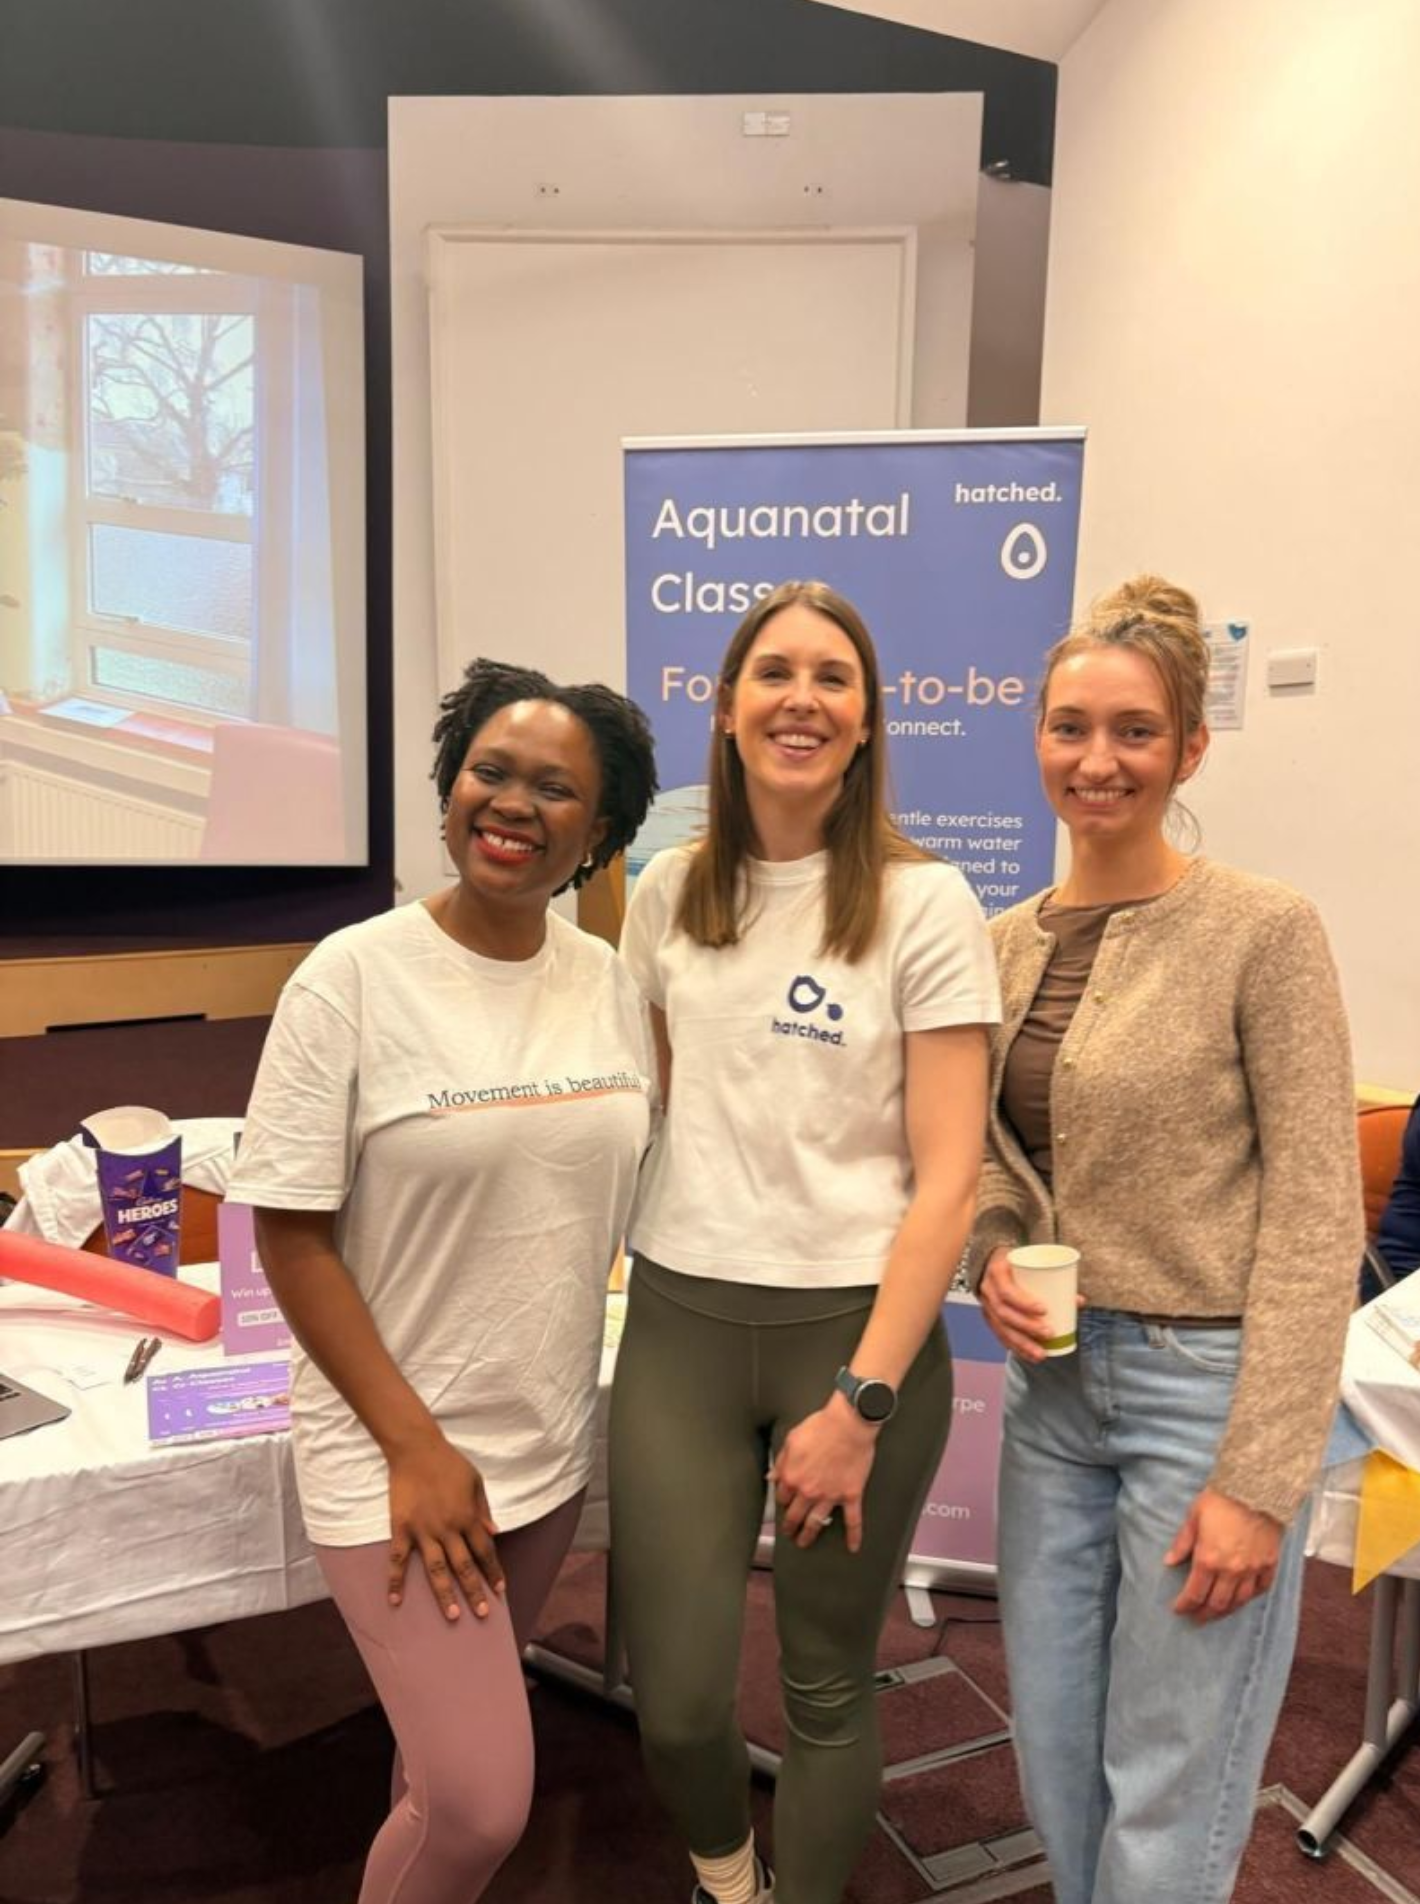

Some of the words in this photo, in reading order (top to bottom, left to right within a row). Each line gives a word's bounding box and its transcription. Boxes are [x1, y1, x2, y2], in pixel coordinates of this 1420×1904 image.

[954, 482, 1063, 504] hatched.
[651, 492, 910, 550] Aquanatal
[651, 570, 774, 614] Class
[661, 666, 719, 703] Fo
[881, 665, 1025, 706] -to-be
[885, 717, 967, 737] onnect.
[936, 810, 1023, 830] exercises
[966, 836, 1023, 852] water
[1001, 860, 1020, 875] to
[975, 883, 1020, 900] your
[771, 1016, 848, 1048] hatched.
[427, 1082, 542, 1110] Movement
[546, 1078, 562, 1097] is
[117, 1198, 179, 1225] HEROES
[952, 1397, 986, 1414] rpe
[922, 1502, 970, 1519] .com
